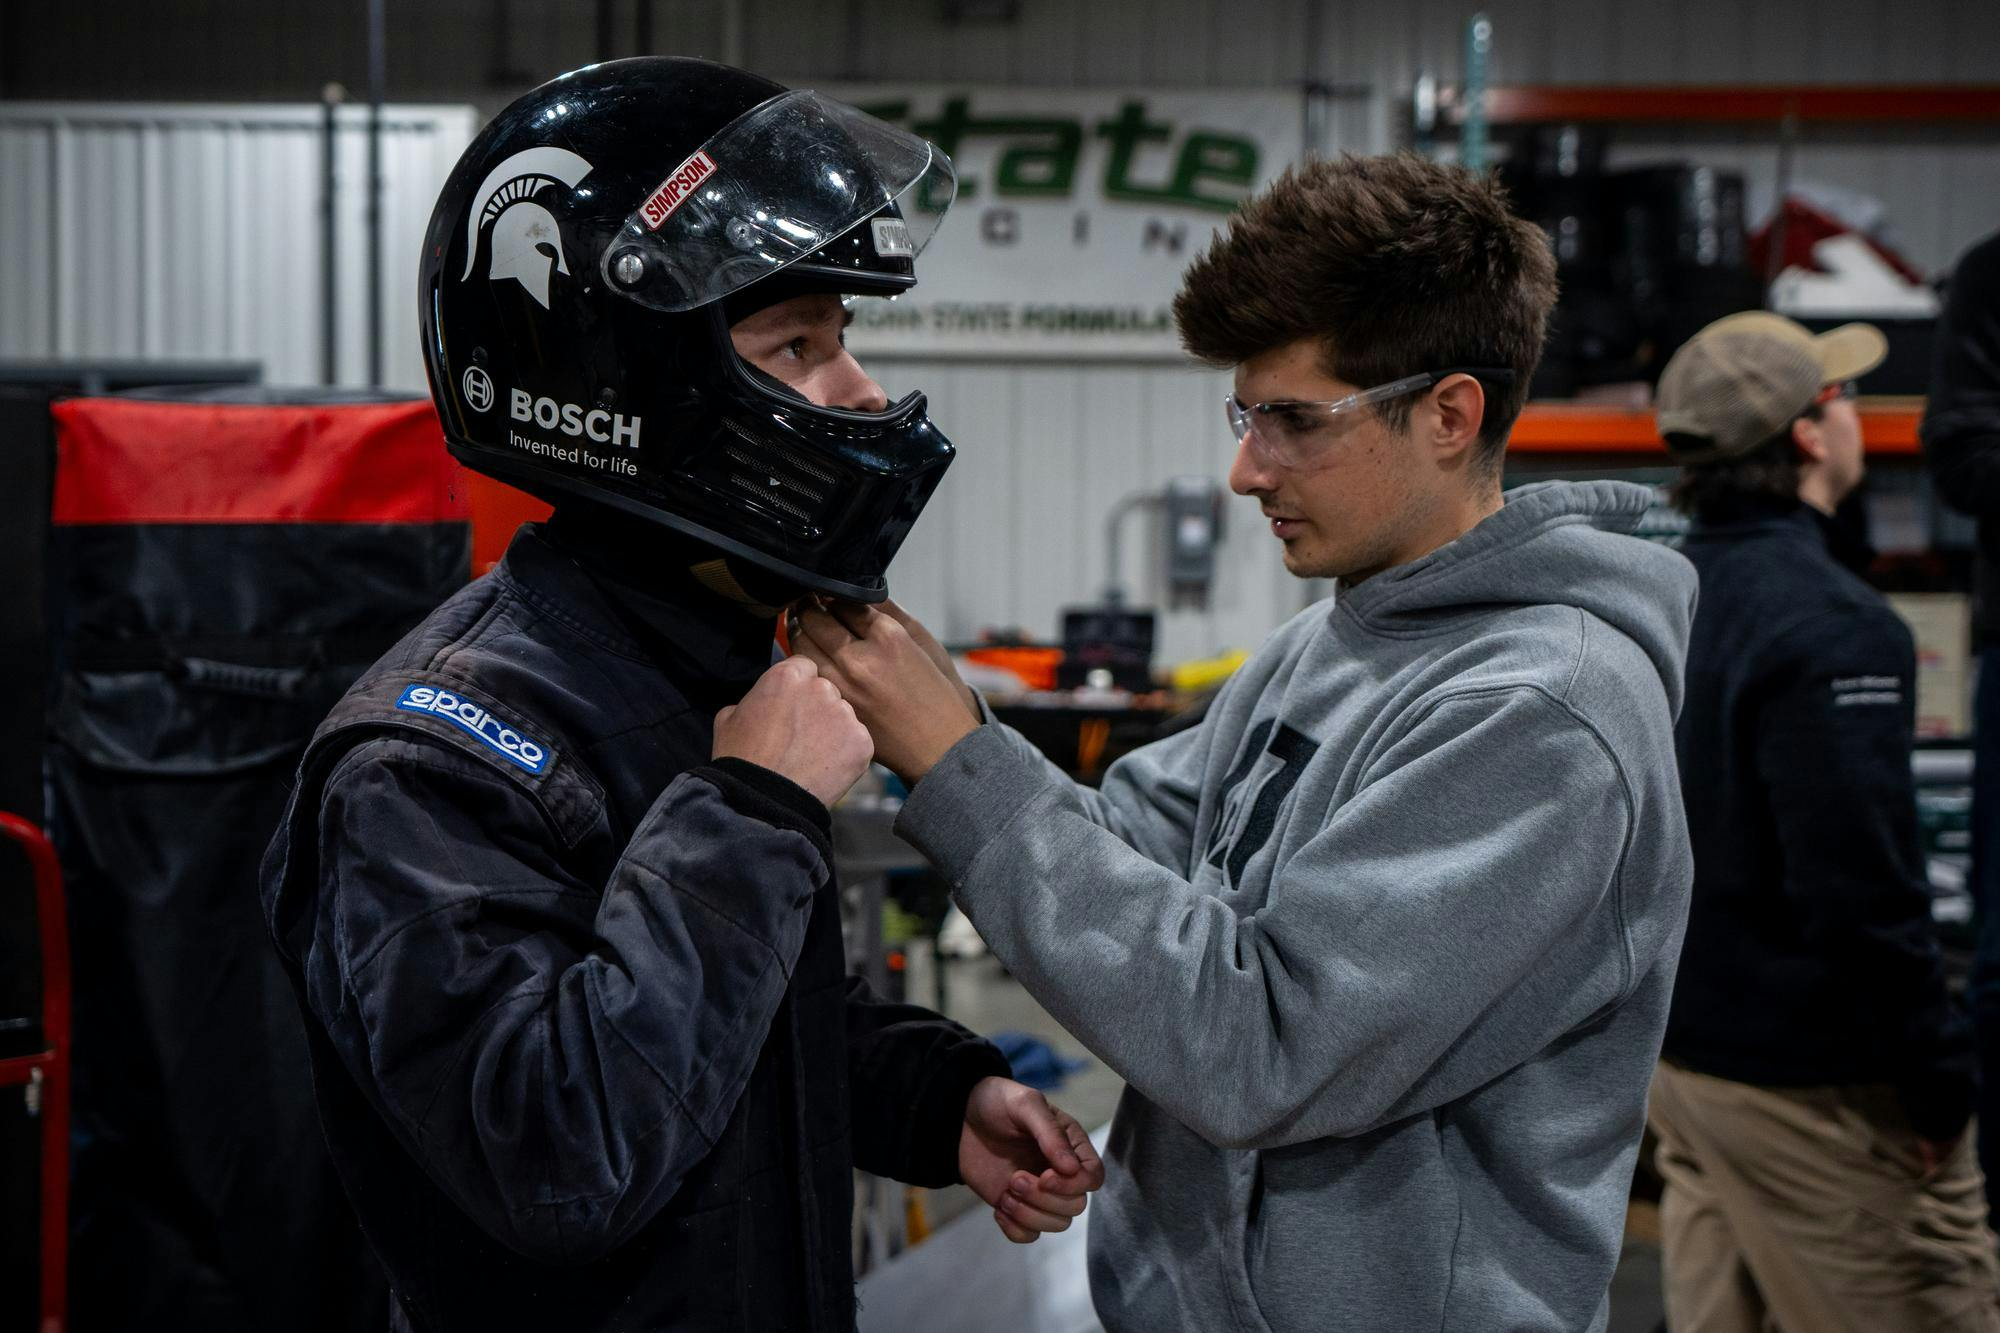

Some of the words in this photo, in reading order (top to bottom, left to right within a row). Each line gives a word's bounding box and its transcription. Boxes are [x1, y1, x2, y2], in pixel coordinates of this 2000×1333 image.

[864, 97, 1259, 214] tate
[645, 156, 709, 223] SIMPSON
[510, 387, 642, 449] BOSCH
[510, 429, 579, 465] Invented
[583, 450, 608, 470] for
[611, 457, 638, 477] life
[409, 687, 544, 763] sparco
